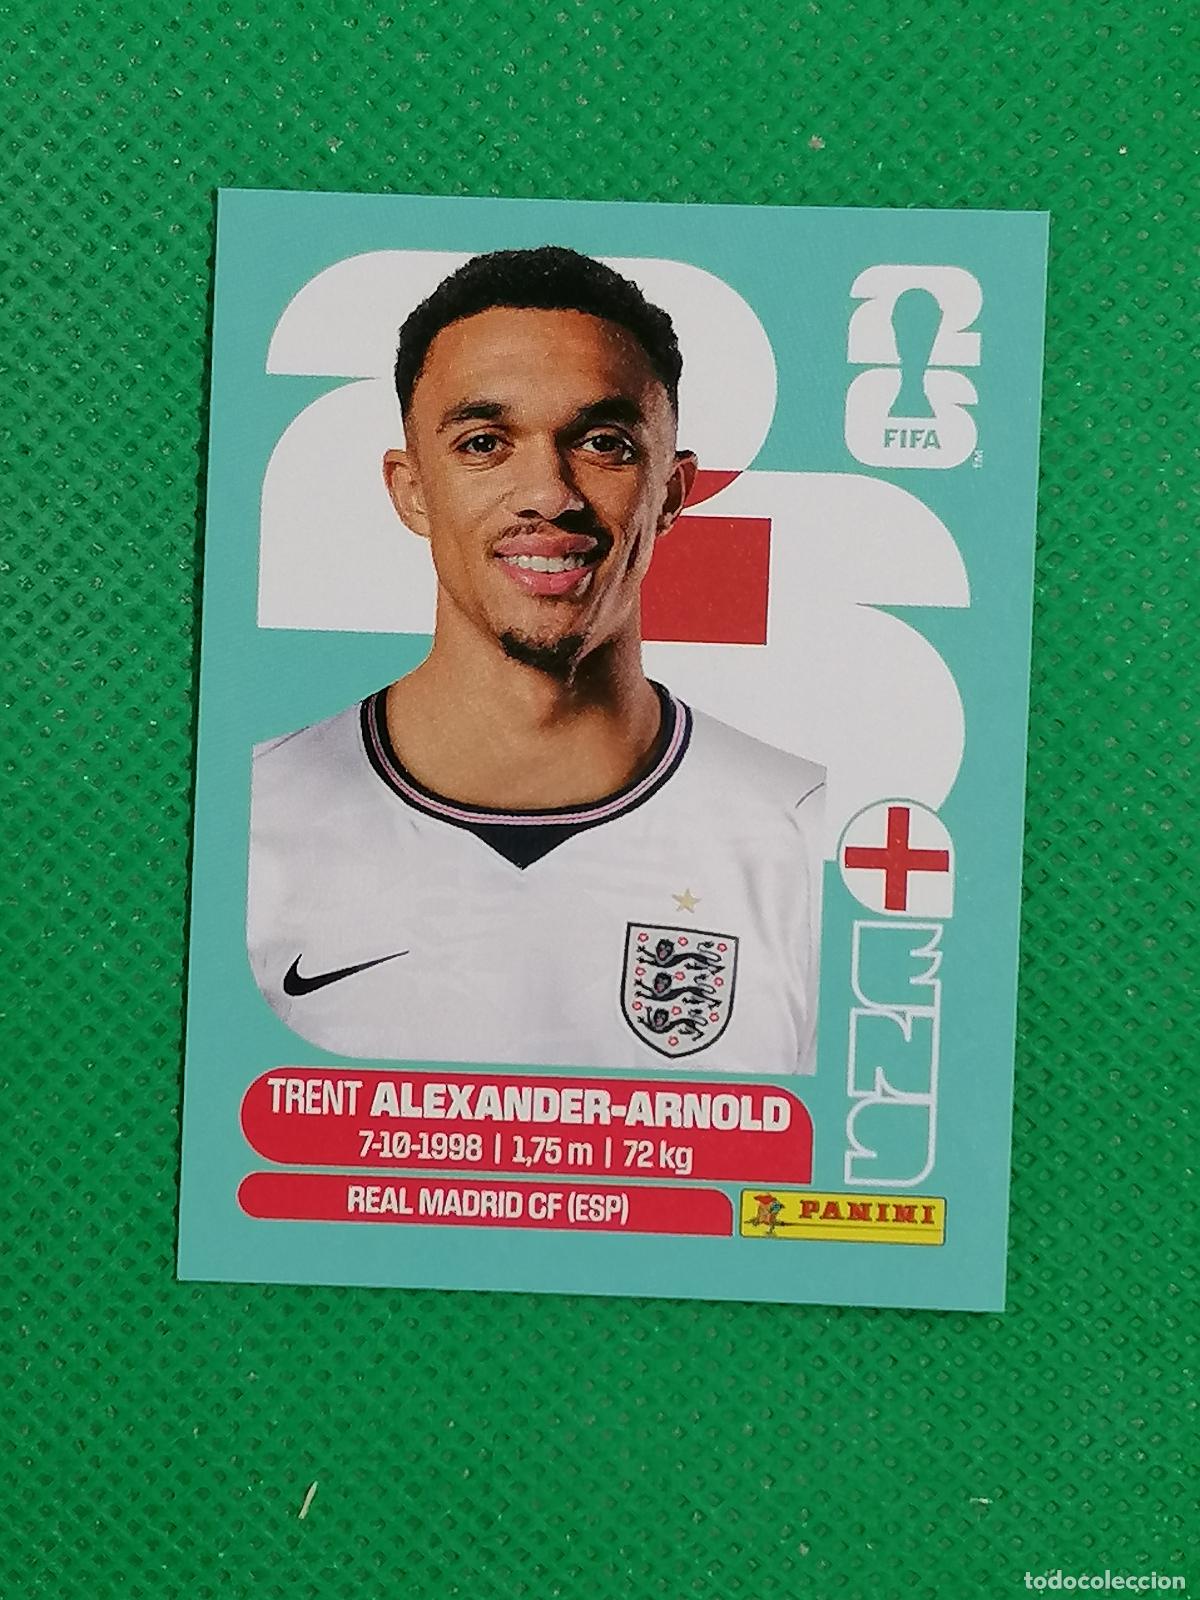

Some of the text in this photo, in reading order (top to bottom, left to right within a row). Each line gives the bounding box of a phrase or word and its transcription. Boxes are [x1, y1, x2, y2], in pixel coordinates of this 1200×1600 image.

[883, 428, 941, 449] FIFA
[267, 1077, 792, 1132] TRENT ALEXANDER-ARNOLD
[358, 1130, 482, 1162] 7-10-1998
[512, 1135, 562, 1168] 1,75
[567, 1140, 593, 1166] m
[622, 1140, 654, 1169] 72
[658, 1139, 694, 1175] kg
[347, 1185, 630, 1226] REAL MADRID CF (ESP)
[799, 1199, 936, 1224] PANINI
